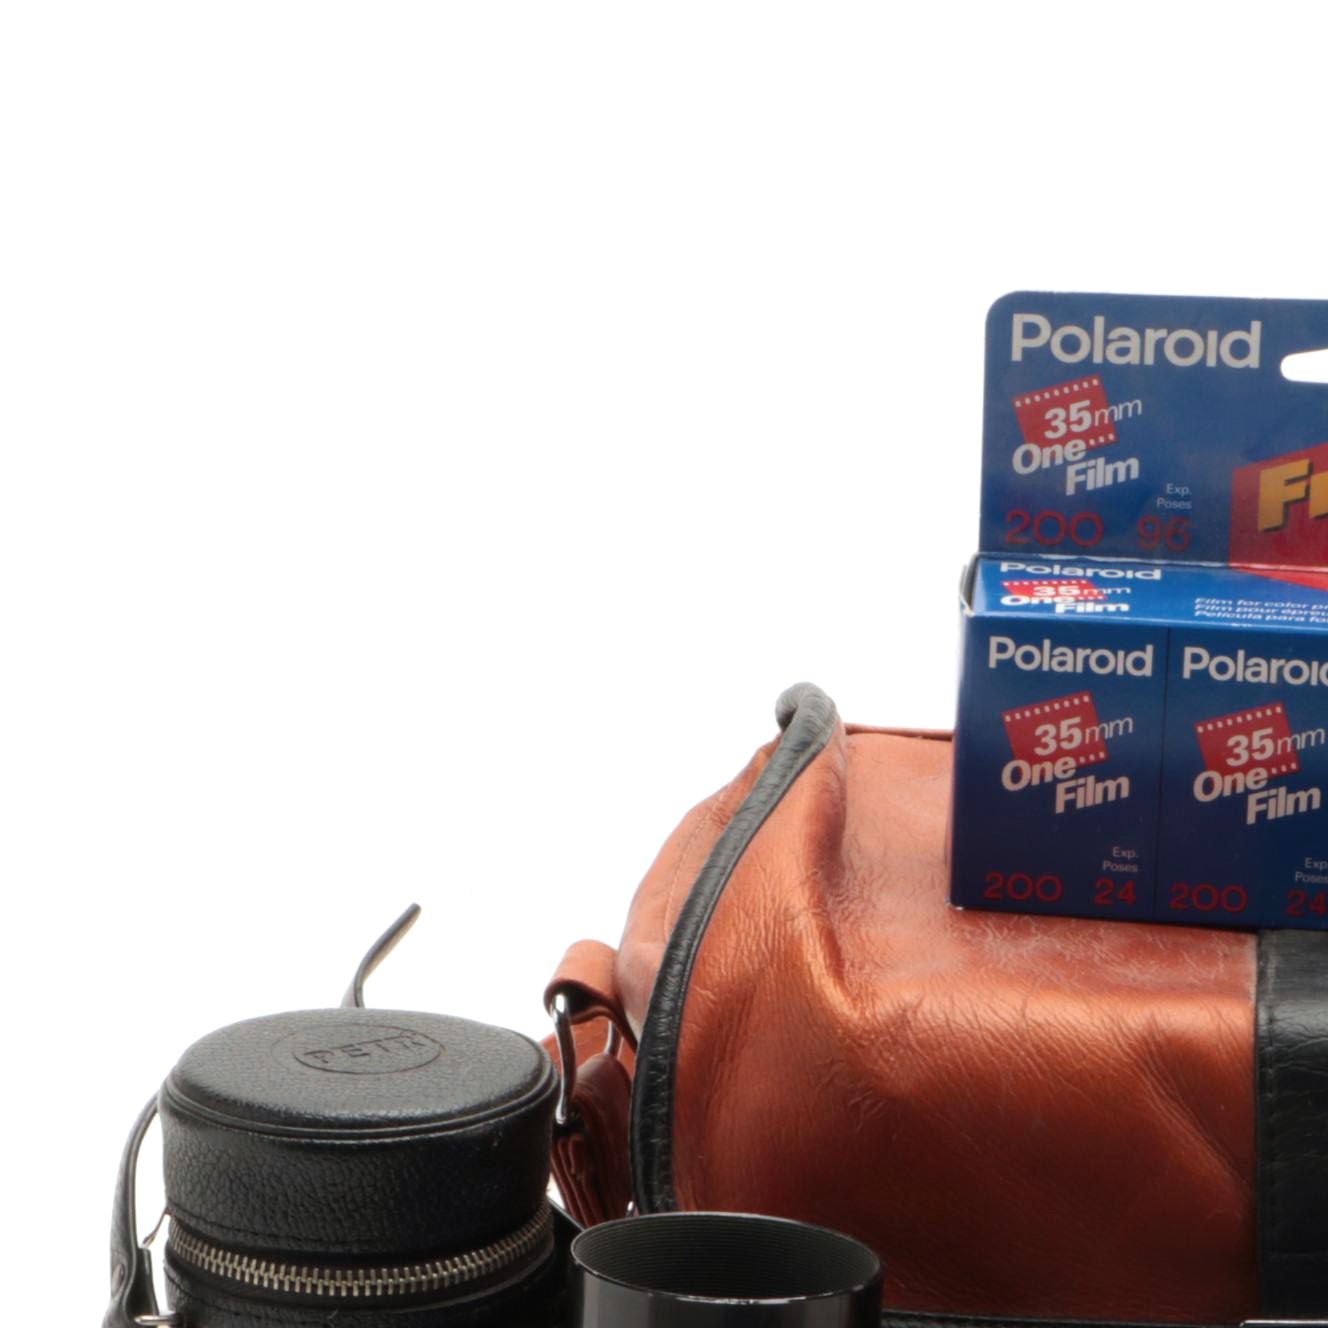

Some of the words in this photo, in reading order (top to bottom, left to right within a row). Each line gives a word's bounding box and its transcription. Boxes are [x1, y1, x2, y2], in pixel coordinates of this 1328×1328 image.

[1011, 313, 1262, 369] Polaroid
[1044, 398, 1142, 440] 35mm
[1012, 437, 1087, 475] One
[1065, 456, 1140, 496] Film
[1166, 483, 1192, 496] Exp.
[1156, 497, 1192, 510] Poses
[1005, 508, 1105, 547] 200
[1137, 515, 1192, 552] 96
[1000, 561, 1162, 580] Polaroid
[1000, 595, 1076, 607] One
[1033, 585, 1132, 597] 35mm
[1055, 602, 1130, 614] Film
[1195, 597, 1232, 606] Film
[1238, 599, 1262, 607] for
[1264, 600, 1309, 610] color
[1195, 603, 1232, 612] Film
[988, 636, 1154, 677] Polaroid
[1034, 716, 1133, 756] 35mm
[1225, 727, 1326, 767] 35mm
[1002, 755, 1076, 792] One
[1193, 766, 1268, 802] One
[1056, 775, 1129, 814] Film
[1247, 786, 1321, 825] Film
[1103, 860, 1138, 873] Poses
[1113, 847, 1139, 860] Exp.
[984, 872, 1063, 902] 200
[1093, 879, 1137, 907] 24
[1169, 883, 1248, 913] 200
[1286, 890, 1328, 918] 24
